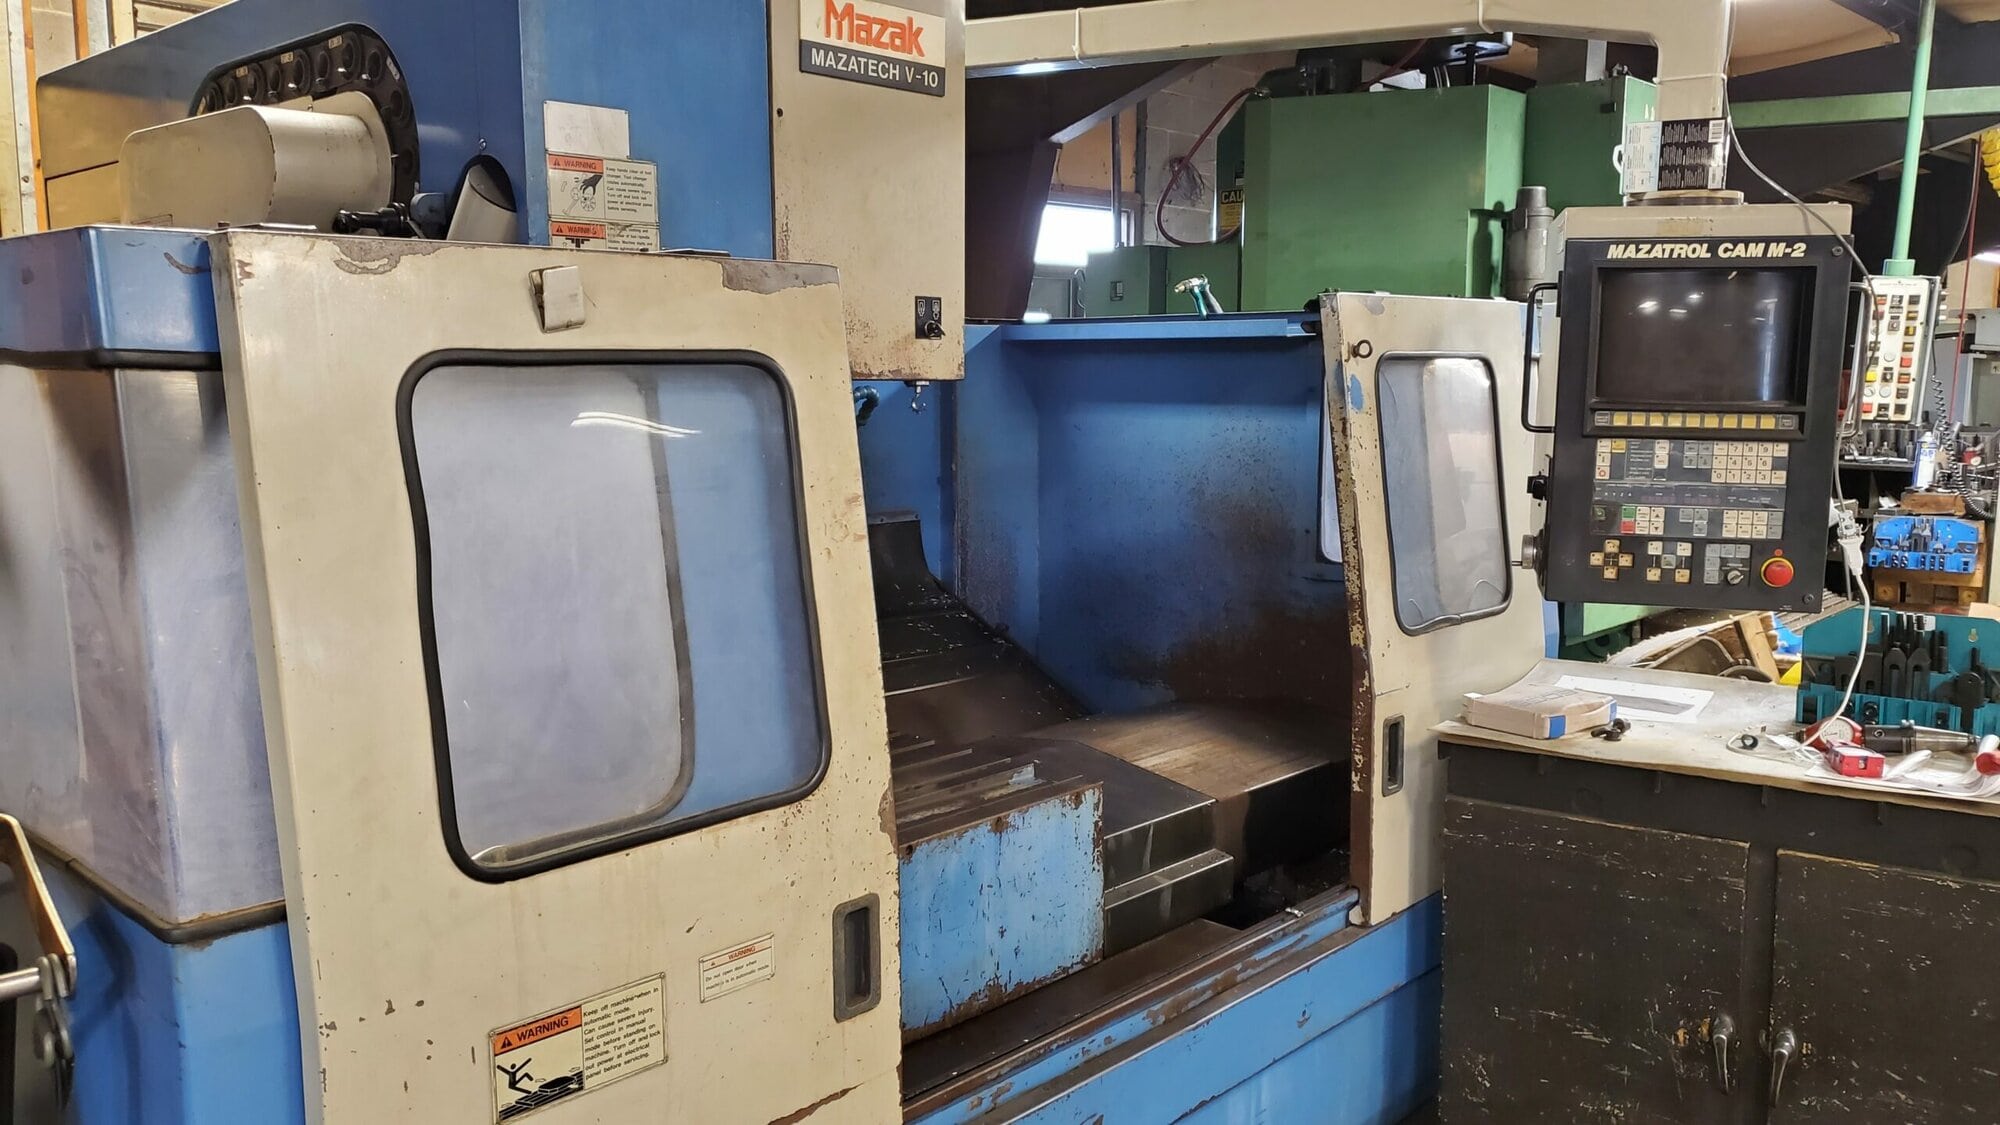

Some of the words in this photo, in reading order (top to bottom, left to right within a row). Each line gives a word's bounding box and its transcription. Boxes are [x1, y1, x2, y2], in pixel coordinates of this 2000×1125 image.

[824, 0, 926, 58] Mazak
[811, 48, 900, 81] MAZATECH
[905, 66, 939, 88] V-10
[564, 160, 596, 170] WARNING
[1607, 243, 1711, 259] MAZATROL
[1718, 242, 1765, 258] CAM
[1767, 242, 1807, 258] M-2
[728, 946, 756, 960] WARNING
[584, 1009, 598, 1018] Keep
[610, 996, 634, 1008] machine
[598, 1021, 615, 1030] cause
[617, 1013, 636, 1023] severe
[638, 1007, 655, 1016] injury.
[516, 1016, 569, 1042] WARNING
[584, 1013, 611, 1026] automatic
[596, 1028, 616, 1040] control
[626, 1017, 646, 1029] manual
[585, 1044, 600, 1052] mode
[603, 1037, 620, 1046] before
[624, 1027, 646, 1039] standing
[597, 1057, 614, 1067] power
[625, 1042, 650, 1056] electrical
[586, 1070, 601, 1080] panel
[604, 1063, 621, 1072] before
